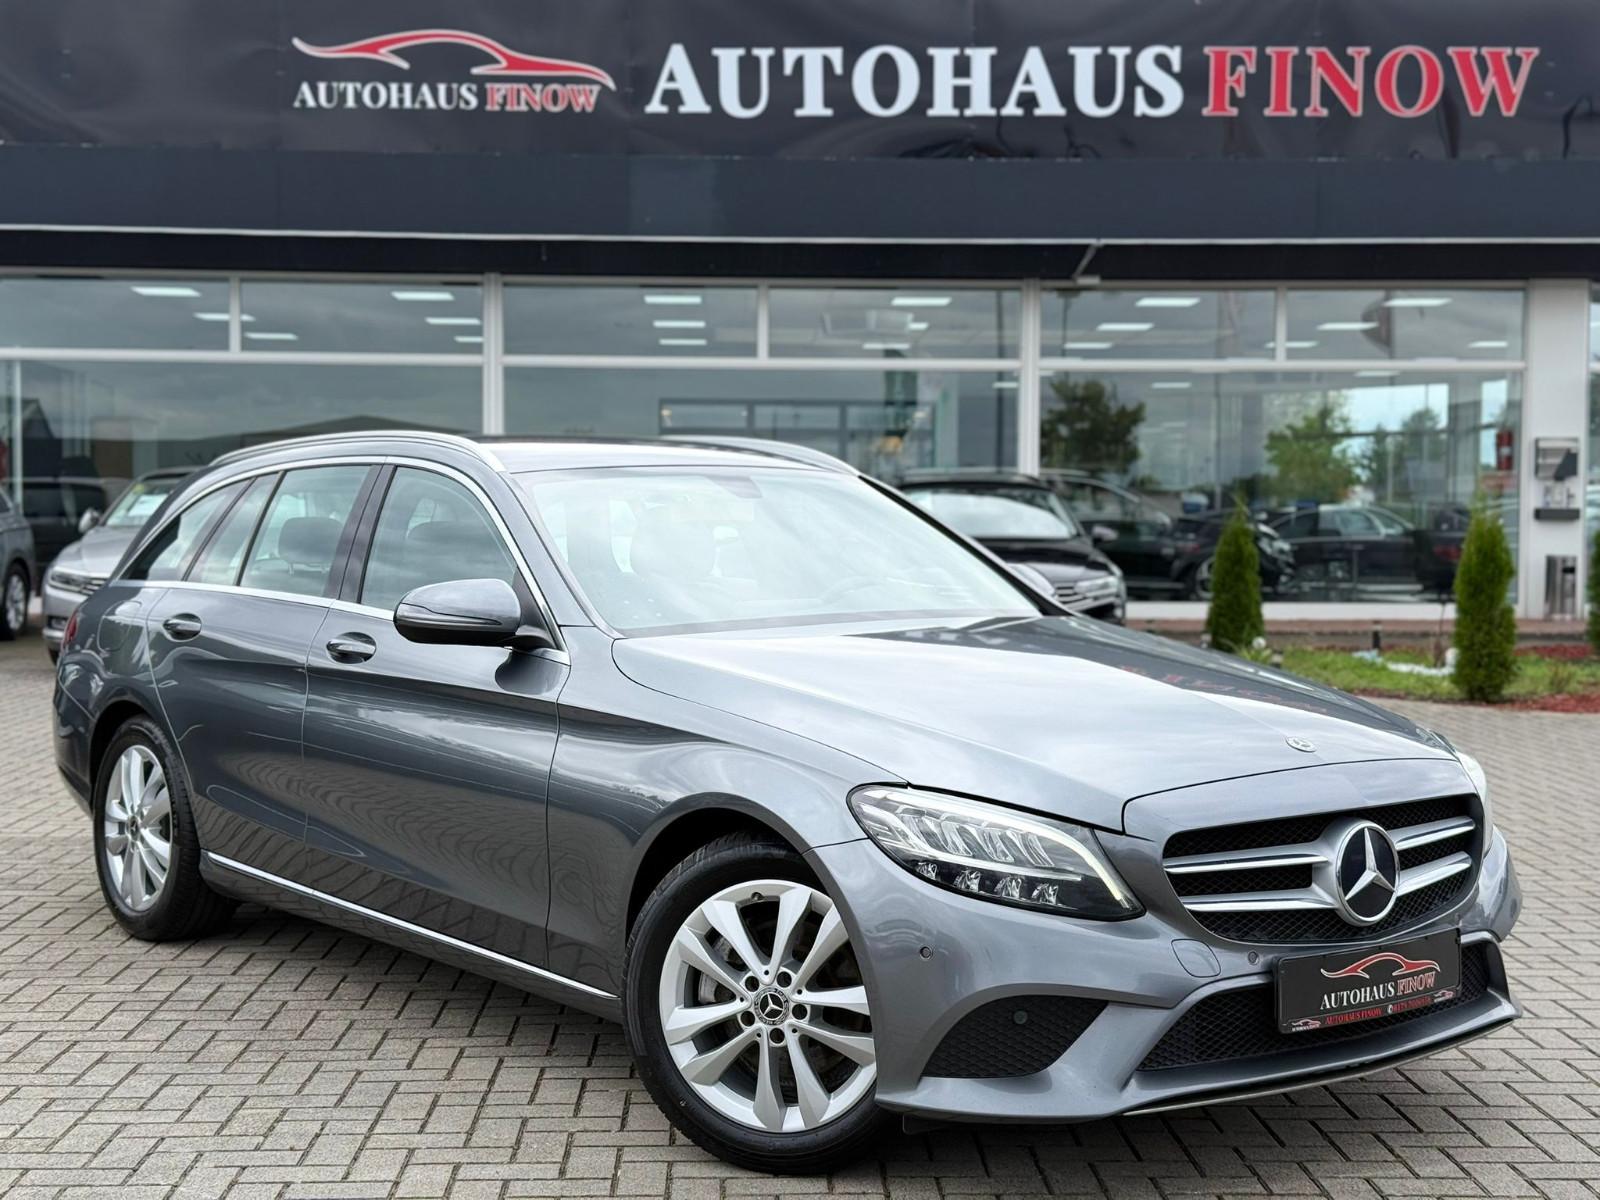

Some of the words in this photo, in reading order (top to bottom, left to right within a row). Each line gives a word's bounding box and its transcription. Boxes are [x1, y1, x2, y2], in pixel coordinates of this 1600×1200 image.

[293, 81, 478, 110] AUTOHAUS
[485, 82, 601, 112] FINOW
[644, 43, 1184, 118] AUTOHAUS
[1202, 45, 1540, 118] FINOW
[1320, 982, 1395, 1010] AUTOHAUS
[1396, 971, 1436, 996] FINOW
[1326, 1011, 1360, 1025] AUTOHAUS
